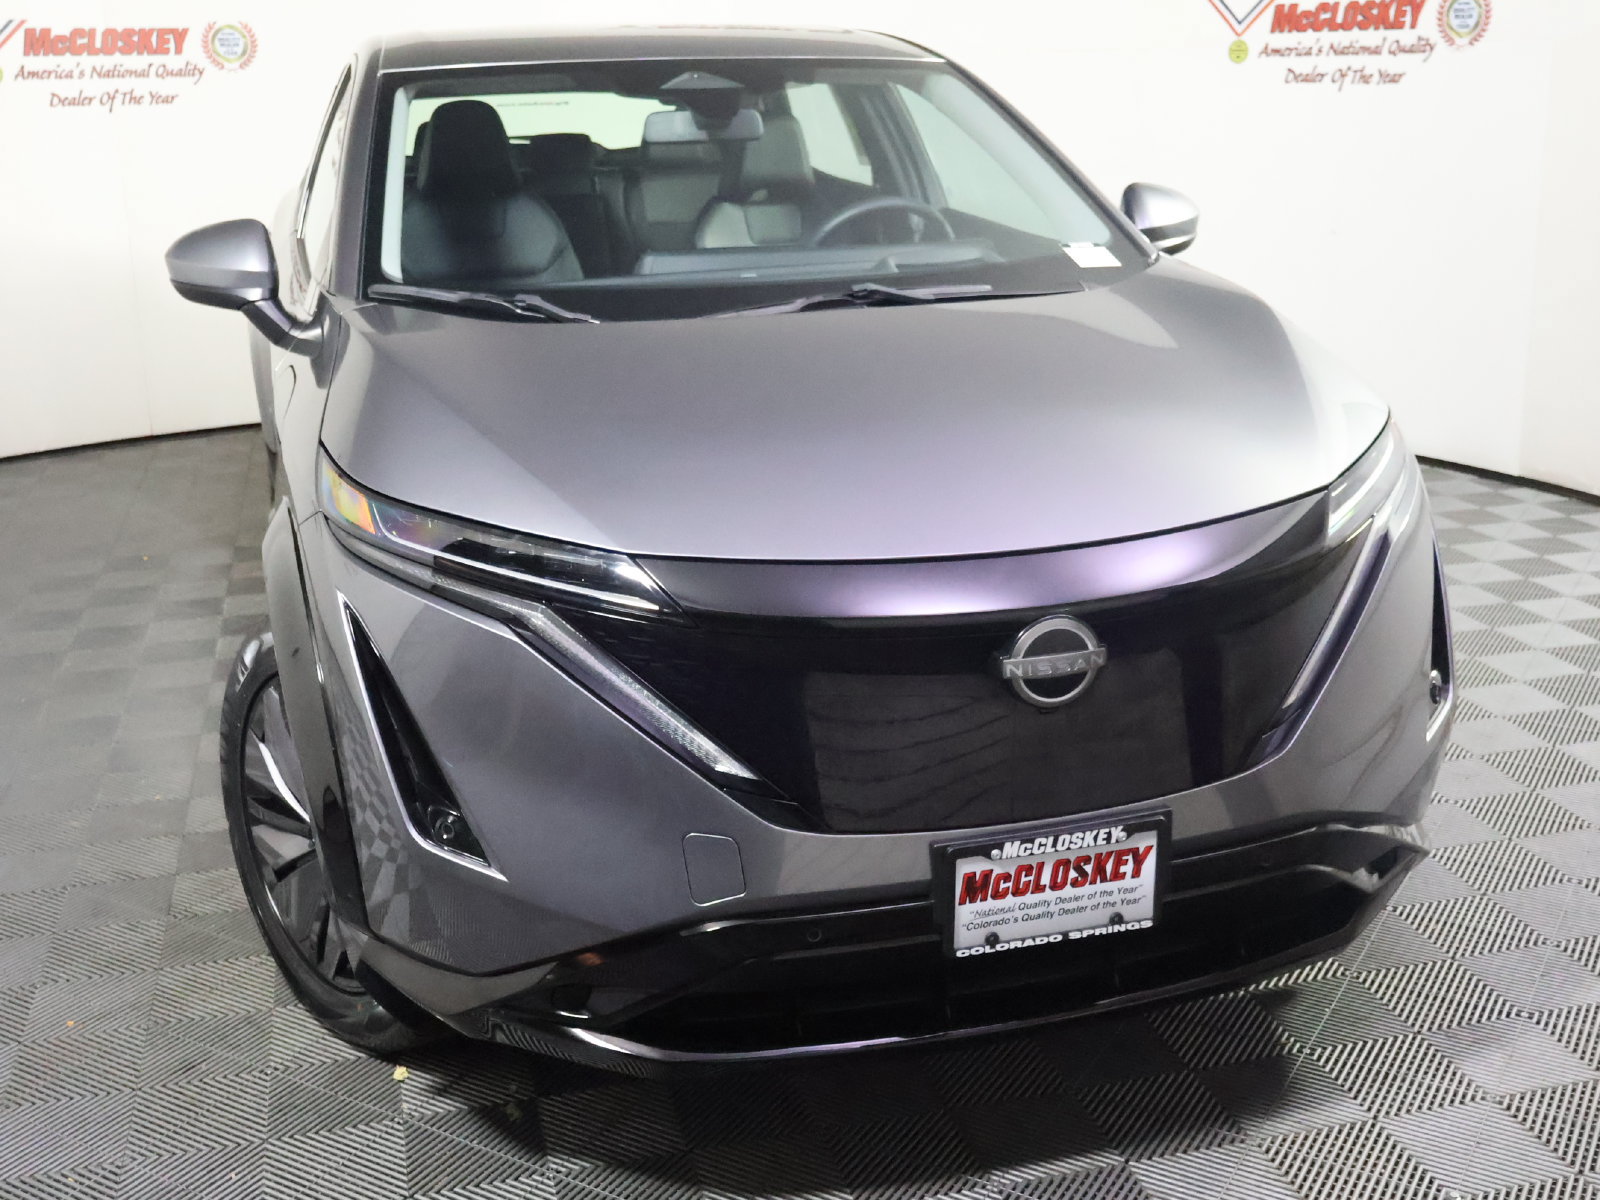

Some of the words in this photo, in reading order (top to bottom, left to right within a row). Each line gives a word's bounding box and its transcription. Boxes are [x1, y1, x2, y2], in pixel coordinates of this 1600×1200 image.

[1270, 0, 1426, 34] McCLOSKEY
[23, 28, 190, 56] McCLOSKEY
[1258, 38, 1323, 58] America's
[1327, 36, 1386, 57] National
[1388, 36, 1436, 63] Quality
[15, 62, 86, 80] America's
[90, 63, 152, 79] National
[155, 61, 205, 86] Quality
[1284, 65, 1328, 84] Dealer
[1331, 65, 1351, 92] Of
[1351, 66, 1373, 84] The
[1376, 67, 1406, 85] Year
[49, 90, 96, 108] Dealer
[99, 88, 119, 113] Of
[120, 88, 145, 106] The
[148, 91, 179, 105] Year
[1005, 653, 1105, 678] NISSAN
[1001, 825, 1124, 860] McCLOSKEY
[958, 845, 1154, 905] McCLOSKEY
[1018, 899, 1052, 911] Quality
[1054, 893, 1085, 906] Dealer
[1087, 891, 1098, 900] of
[1100, 889, 1114, 899] the
[1021, 911, 1056, 922] Quality
[1058, 905, 1088, 917] Dealer
[1090, 902, 1101, 911] of
[1103, 900, 1117, 909] the
[956, 934, 1063, 958] COLORADO
[1068, 920, 1154, 940] SPRINGS
